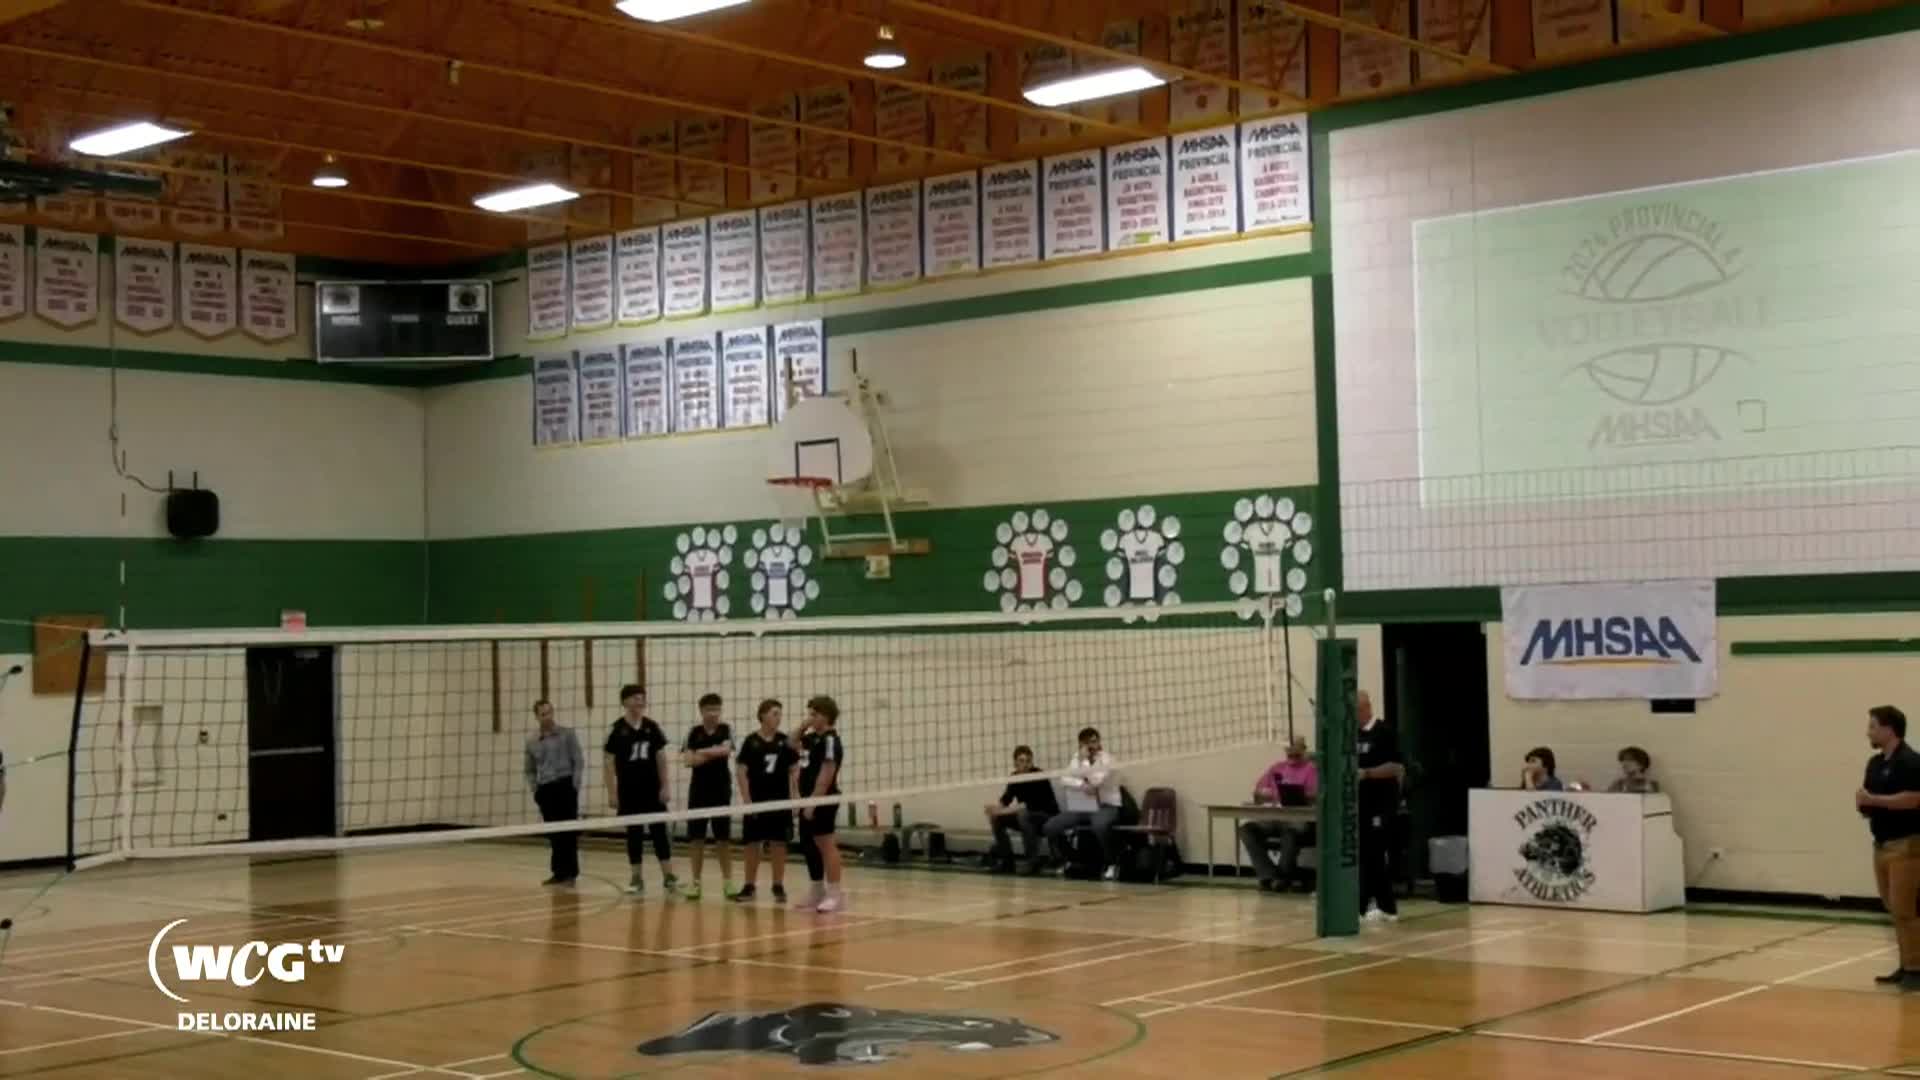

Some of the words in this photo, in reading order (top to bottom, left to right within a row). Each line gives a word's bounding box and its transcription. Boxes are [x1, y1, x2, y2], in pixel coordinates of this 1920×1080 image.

[1179, 134, 1230, 154] MHSAA
[1179, 152, 1230, 170] PROVINCIAL
[1520, 616, 1702, 666] MHSAA
[1514, 798, 1598, 833] PANTHER
[1513, 867, 1597, 902] ATHLETICS
